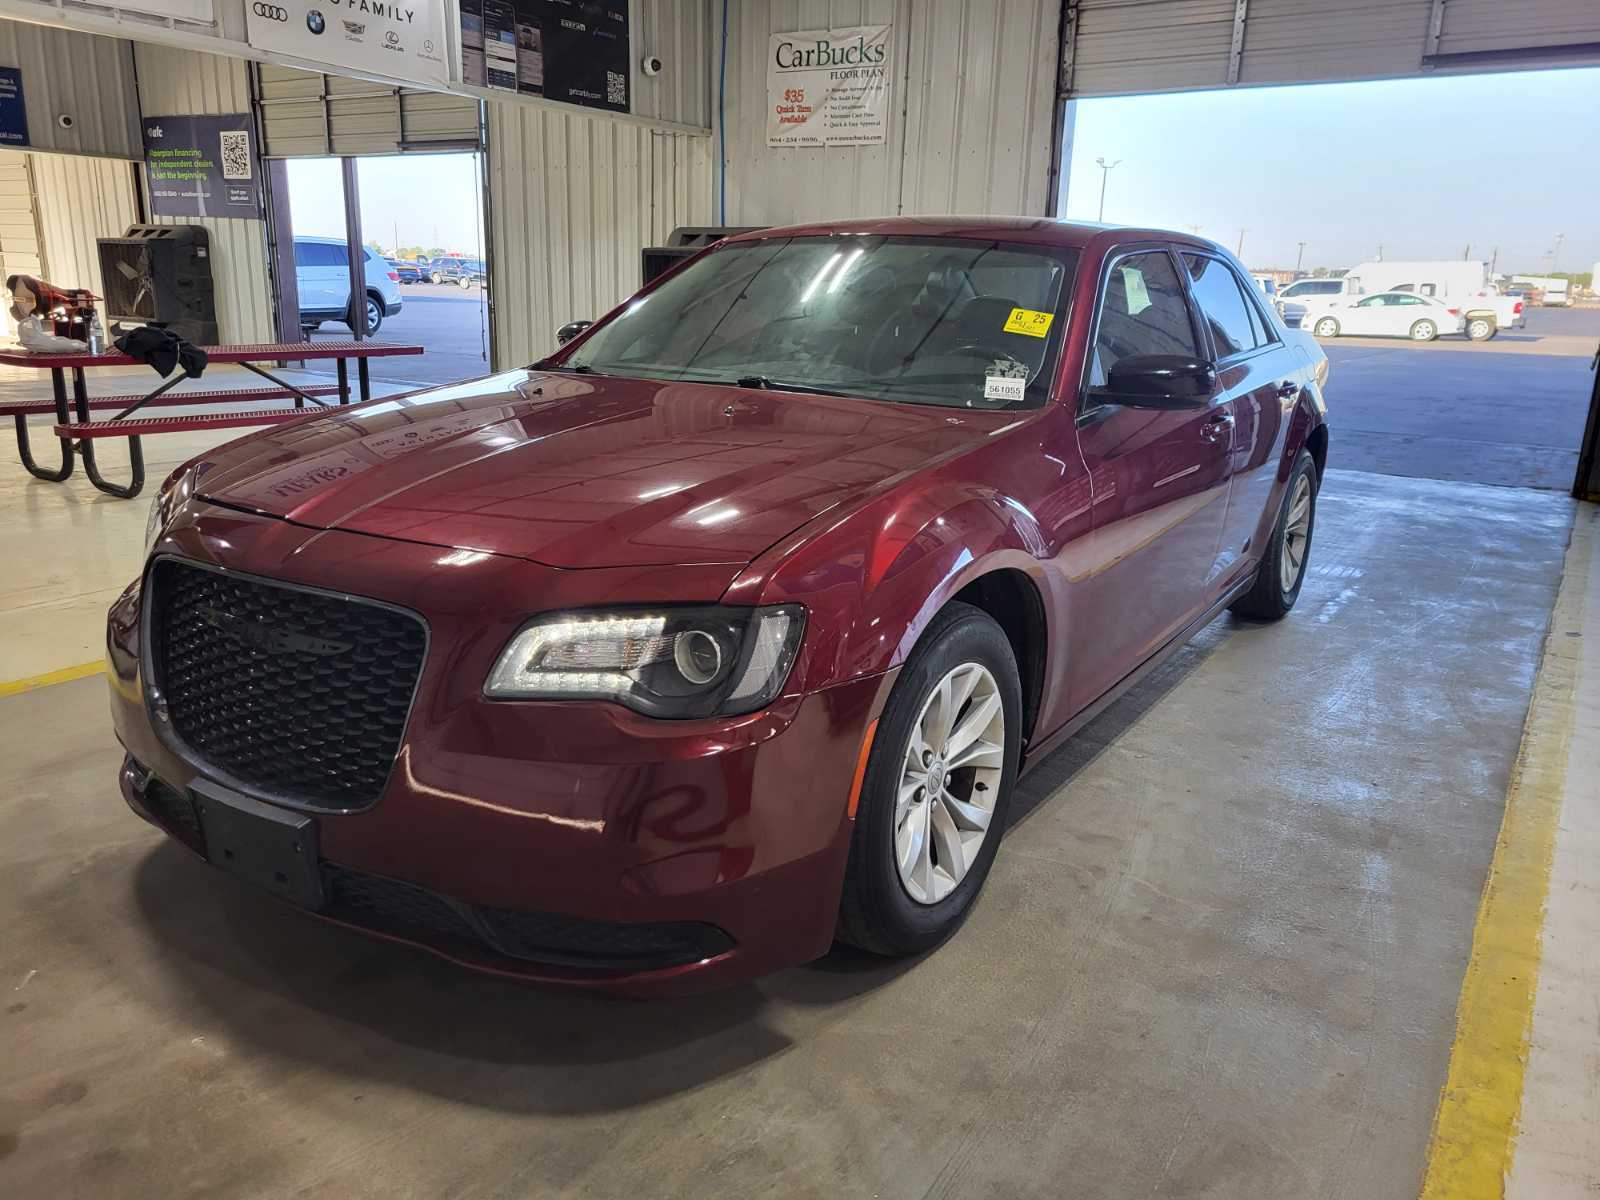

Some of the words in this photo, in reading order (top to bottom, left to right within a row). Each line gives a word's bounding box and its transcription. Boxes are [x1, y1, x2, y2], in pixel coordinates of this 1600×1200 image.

[349, 0, 414, 23] FAMILY
[776, 37, 885, 68] CarBucks
[830, 70, 858, 80] FLOOR
[861, 68, 885, 78] PLAN
[784, 89, 804, 103] $35
[776, 105, 795, 114] Quick
[152, 126, 163, 138] afc
[1016, 312, 1024, 321] G
[1033, 313, 1047, 324] 25
[989, 385, 1021, 395] 561055
